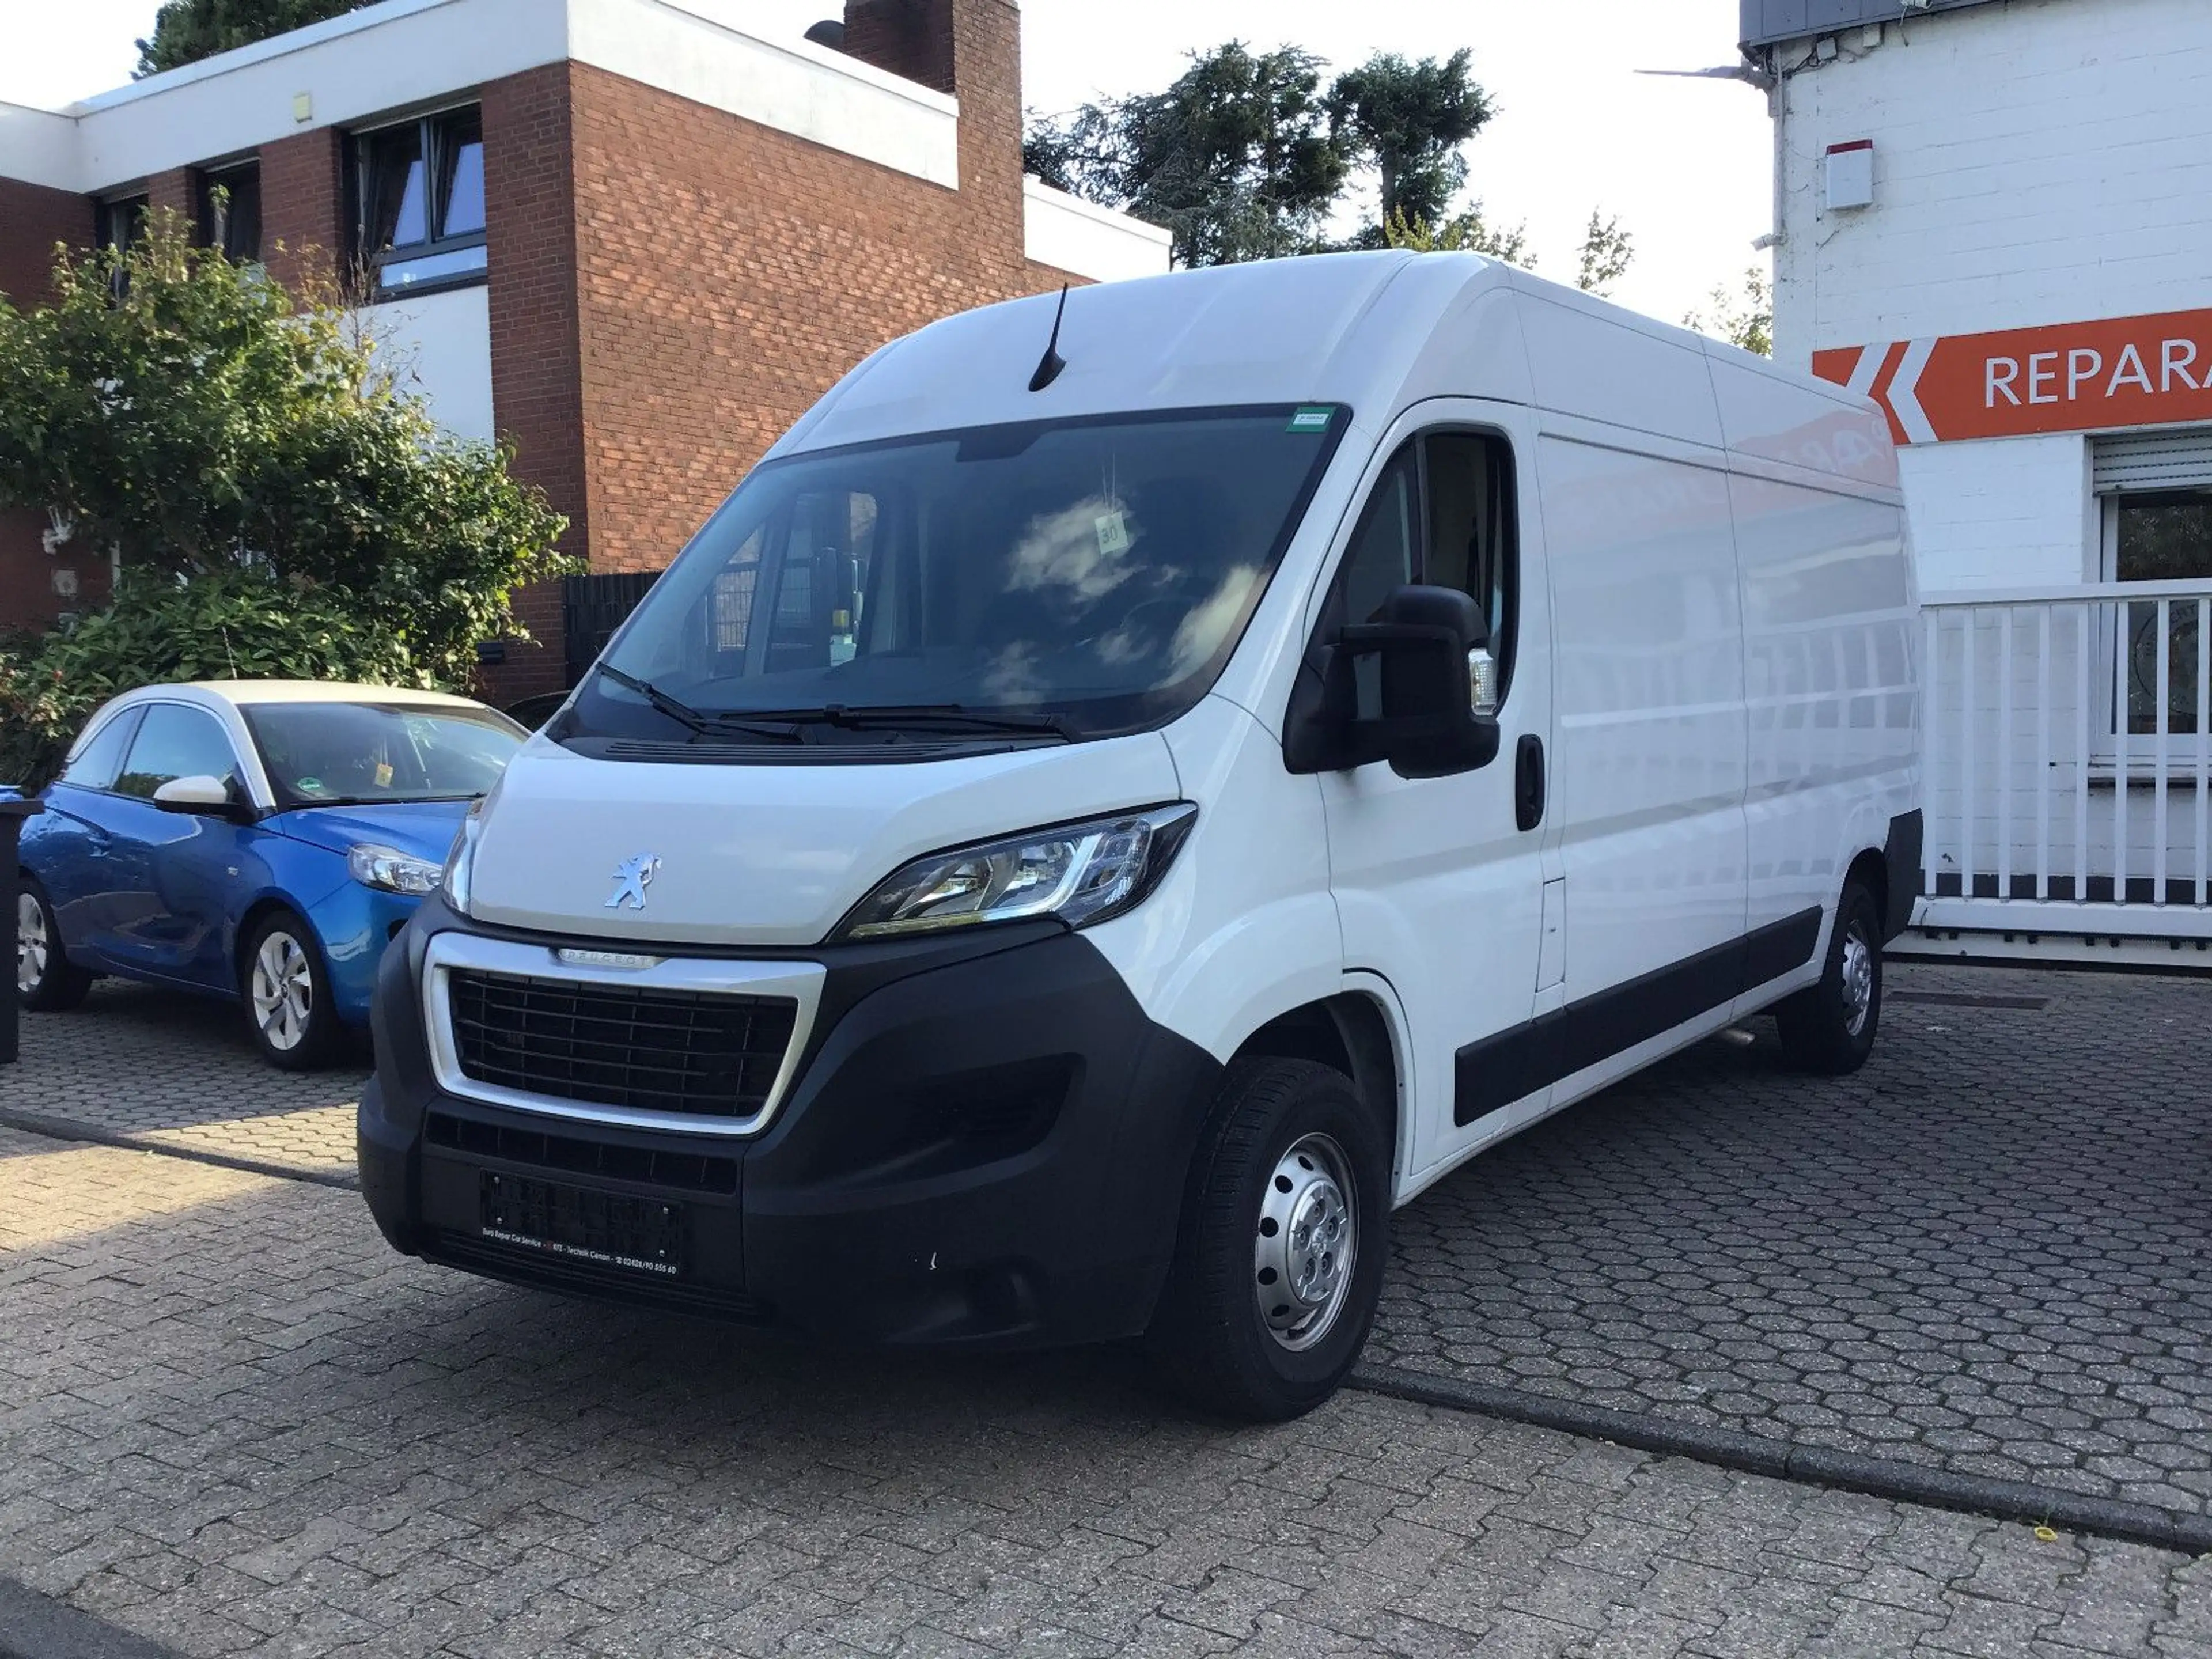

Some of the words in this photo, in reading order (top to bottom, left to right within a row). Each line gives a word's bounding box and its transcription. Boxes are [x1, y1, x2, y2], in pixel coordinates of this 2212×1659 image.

[1985, 339, 2212, 408] REPAR
[1101, 525, 1118, 544] 30
[567, 950, 647, 965] PEUGEOT
